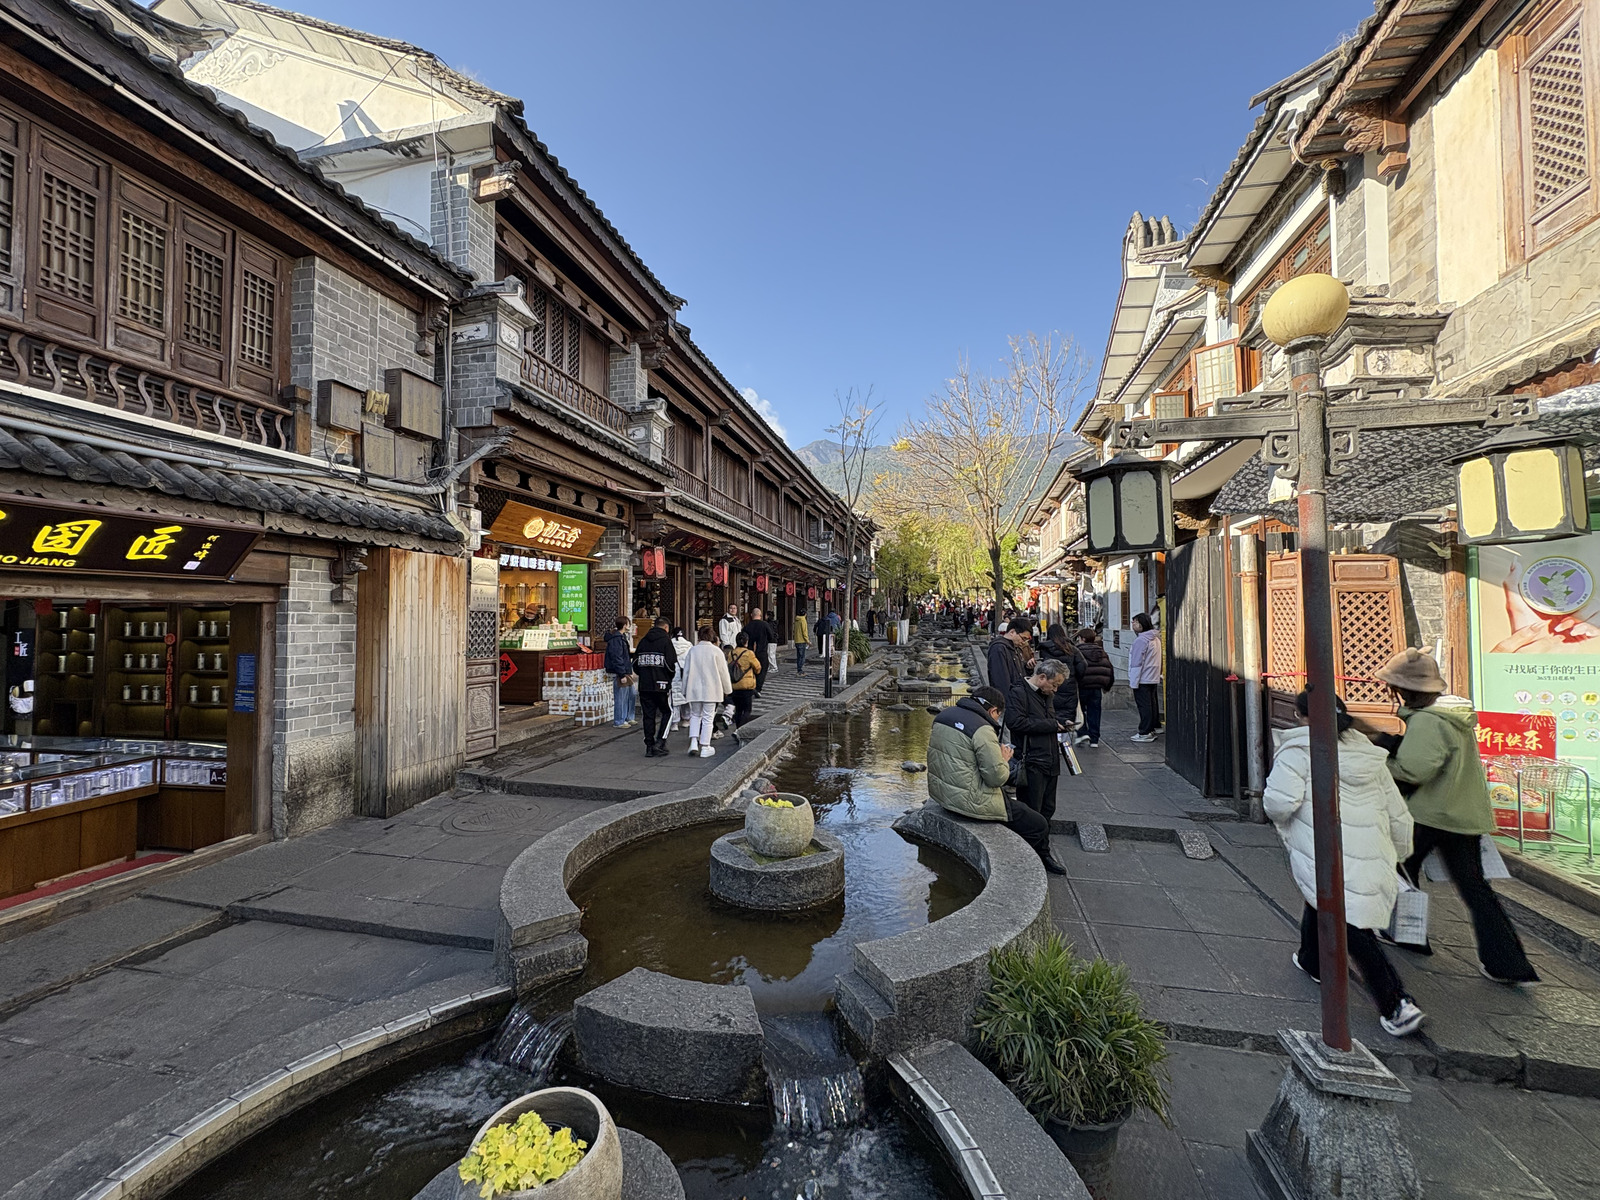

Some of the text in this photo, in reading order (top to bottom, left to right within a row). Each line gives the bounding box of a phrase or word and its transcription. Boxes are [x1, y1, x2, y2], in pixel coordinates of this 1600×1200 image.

[19, 556, 77, 567] JIANG
[1473, 722, 1543, 752] 新年快乐
